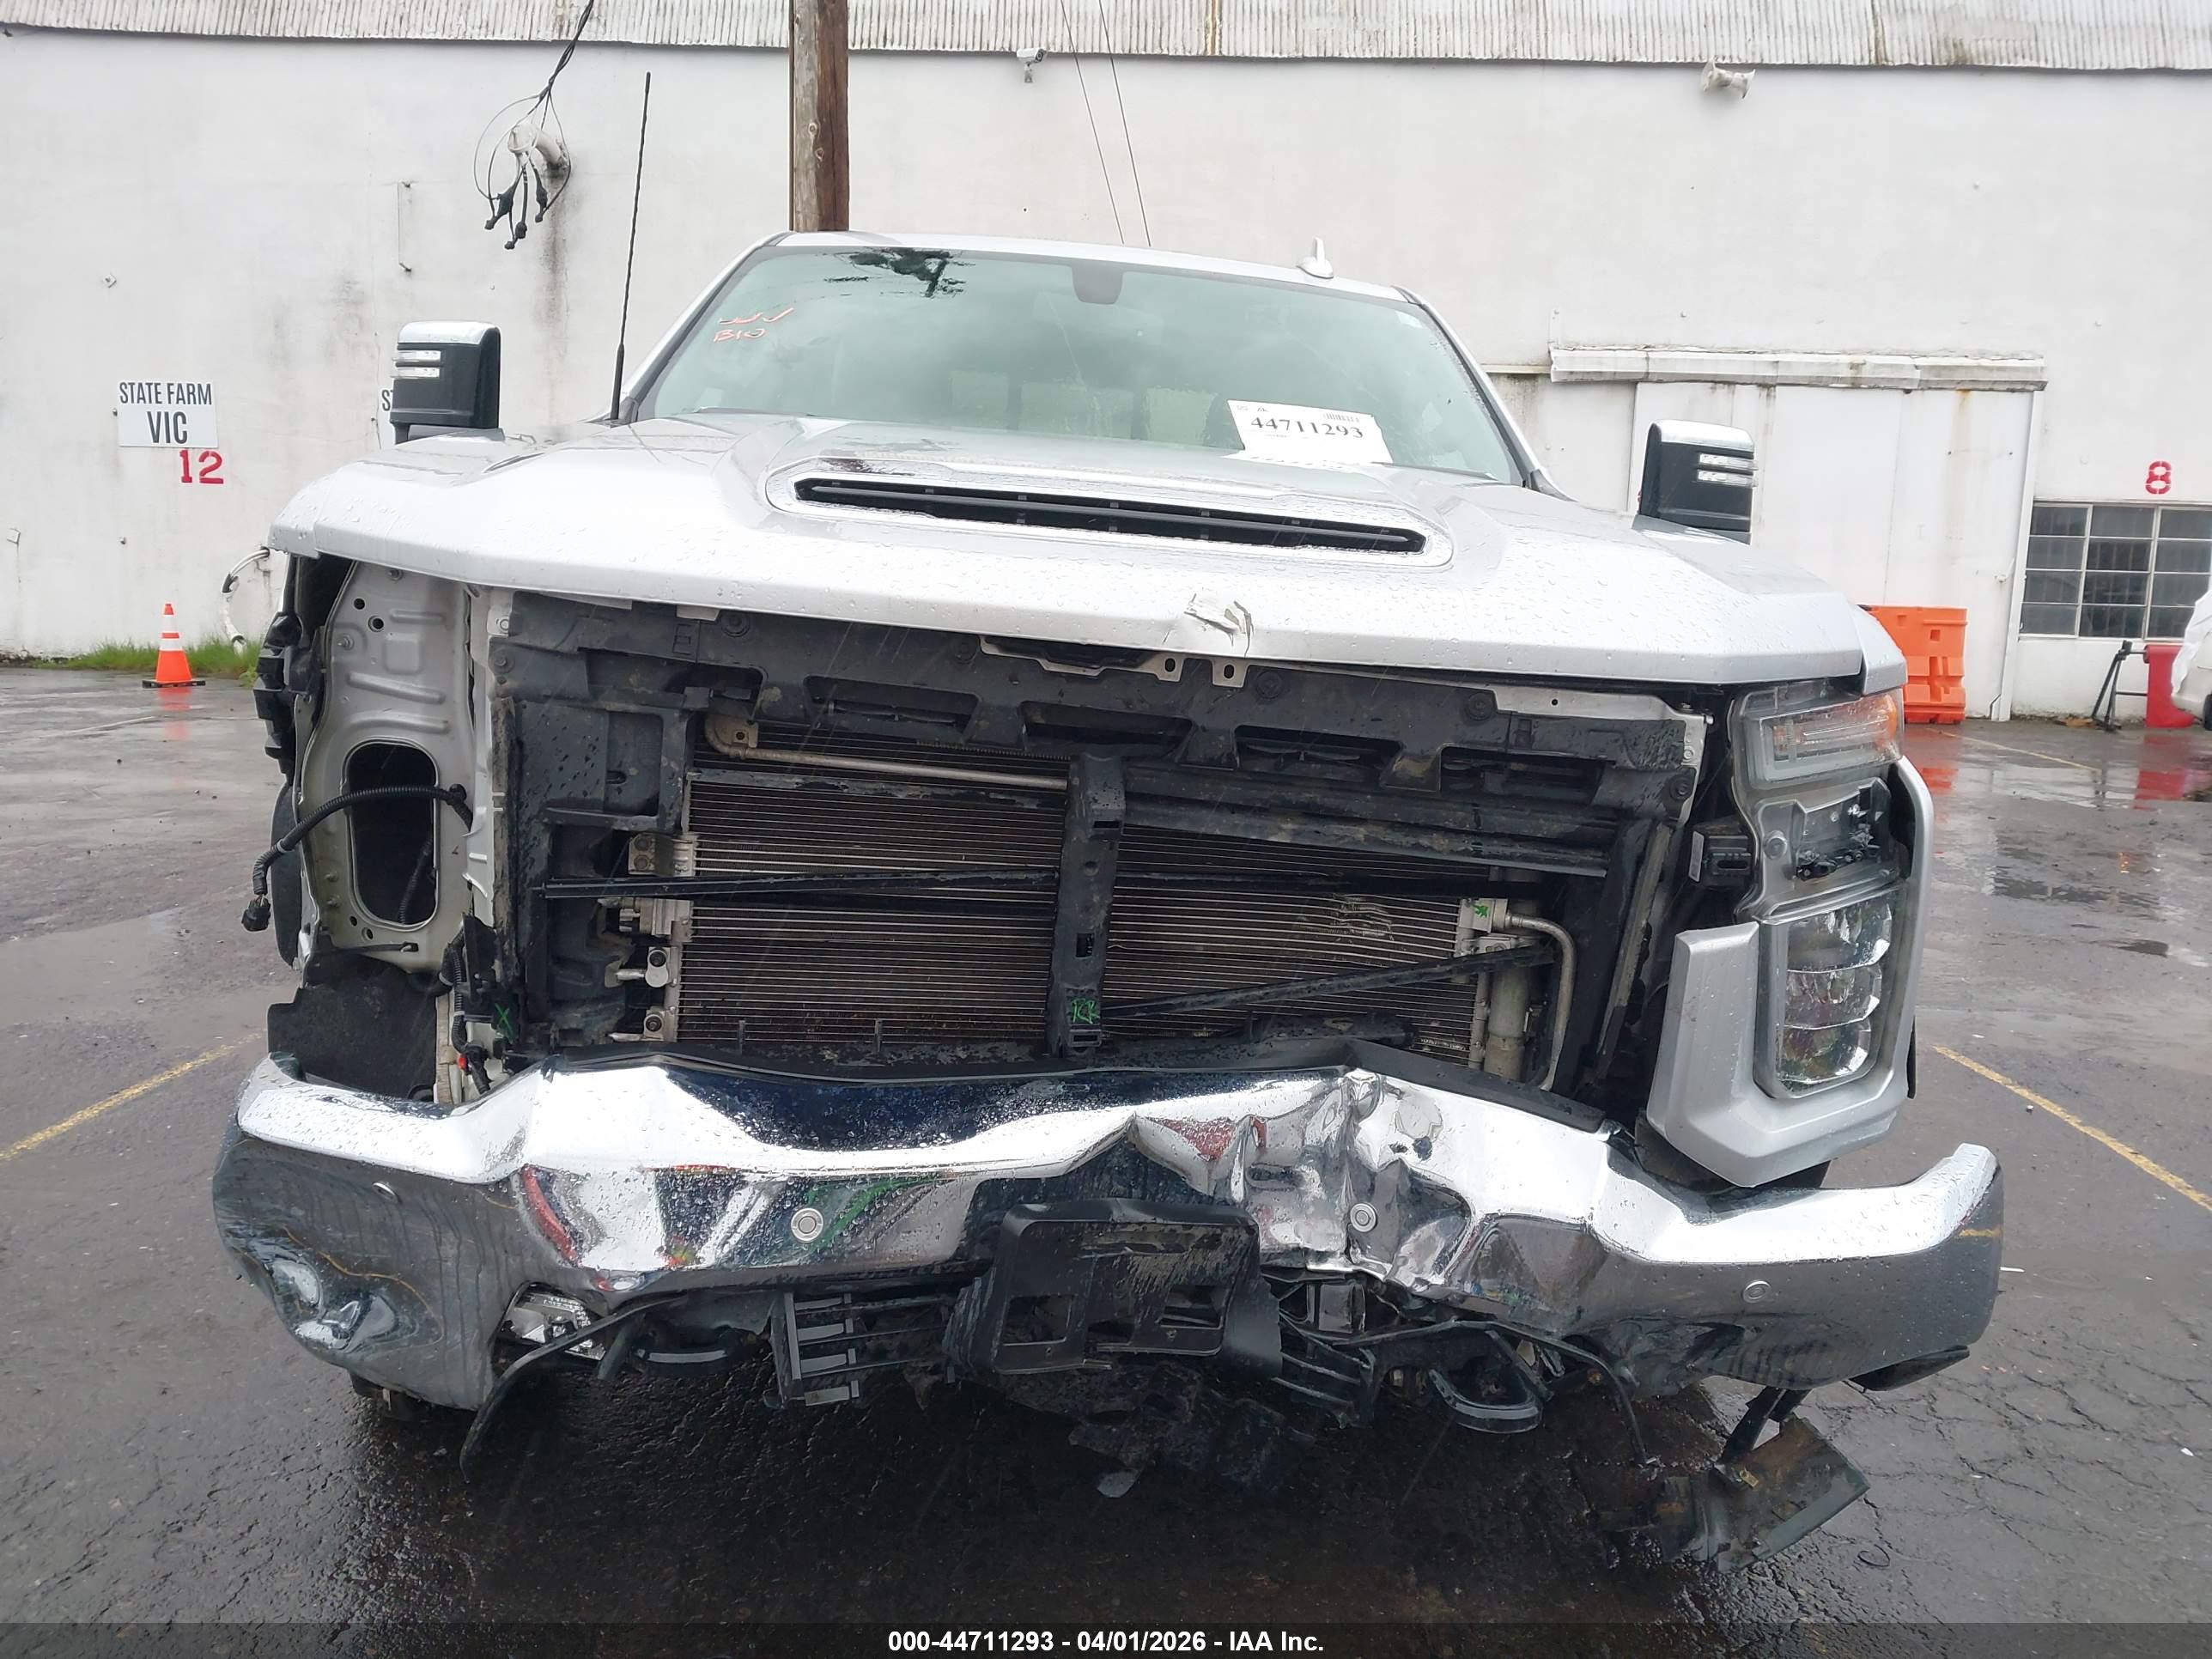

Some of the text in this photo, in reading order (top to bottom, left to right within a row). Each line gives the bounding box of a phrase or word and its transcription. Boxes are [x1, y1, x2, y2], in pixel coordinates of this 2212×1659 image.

[119, 381, 212, 405] STATE FARM
[146, 410, 188, 444] VIC
[1250, 416, 1364, 439] 44711293
[179, 449, 224, 484] 12
[2145, 460, 2172, 495] 8
